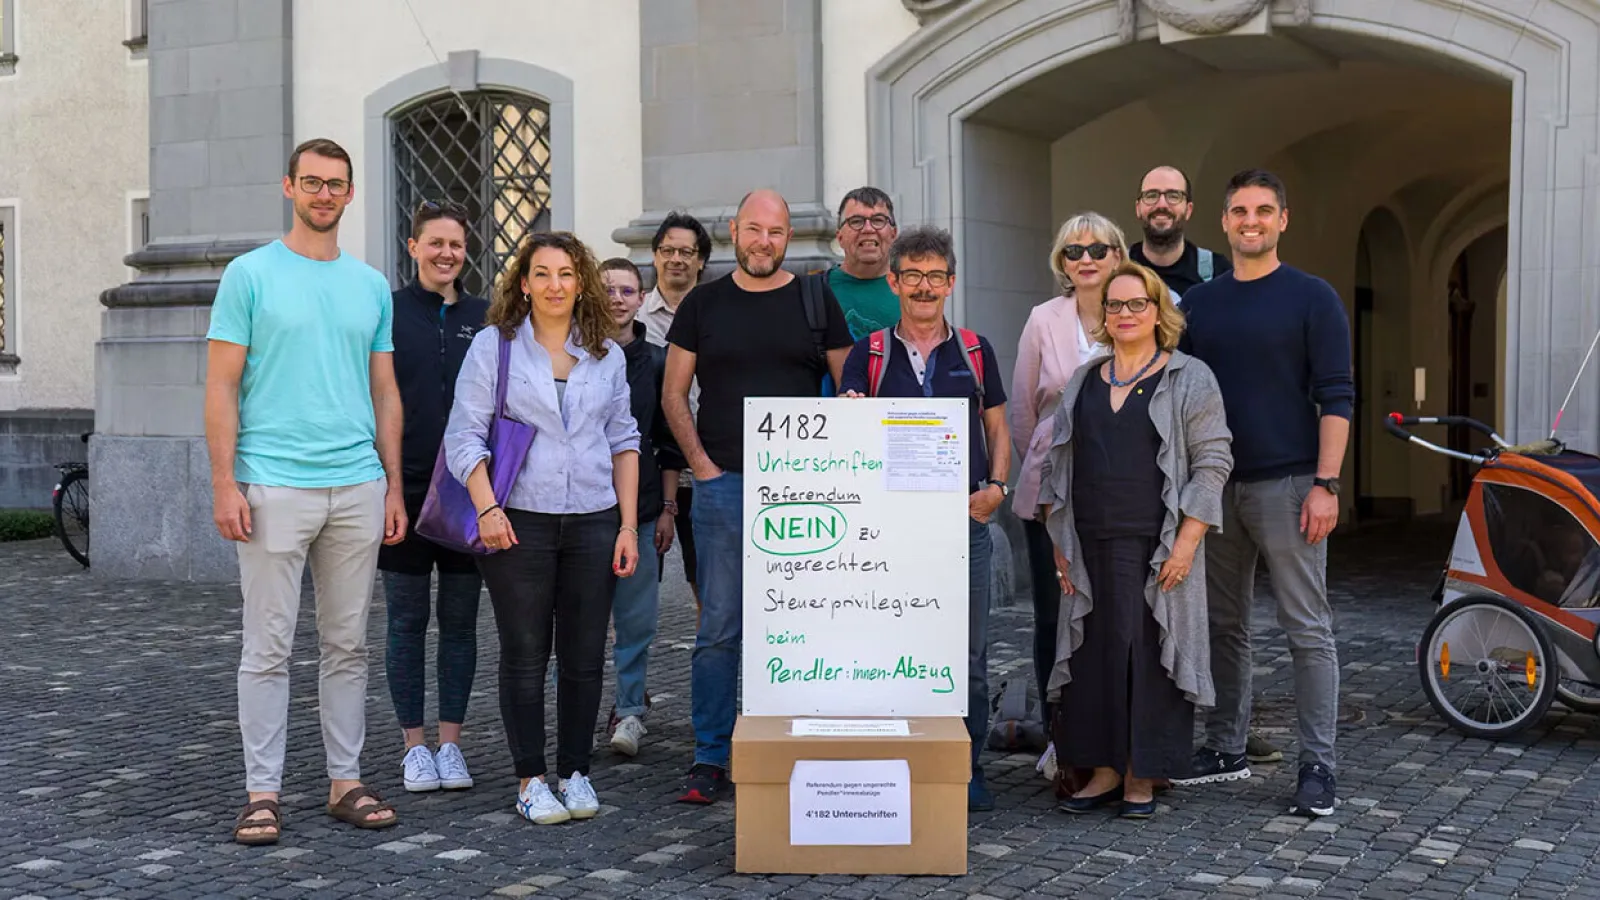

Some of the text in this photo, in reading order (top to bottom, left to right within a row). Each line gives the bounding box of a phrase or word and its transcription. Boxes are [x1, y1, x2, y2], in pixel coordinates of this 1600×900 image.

[757, 412, 828, 441] 4182
[757, 450, 883, 476] Unterschriften
[757, 485, 861, 503] Referendum
[764, 515, 881, 541] NEIN zu
[766, 552, 889, 580] ungerechten
[764, 588, 940, 620] Steuerprivilegien
[766, 625, 806, 645] beim
[805, 810, 898, 819] 4'182 Unterschriften
